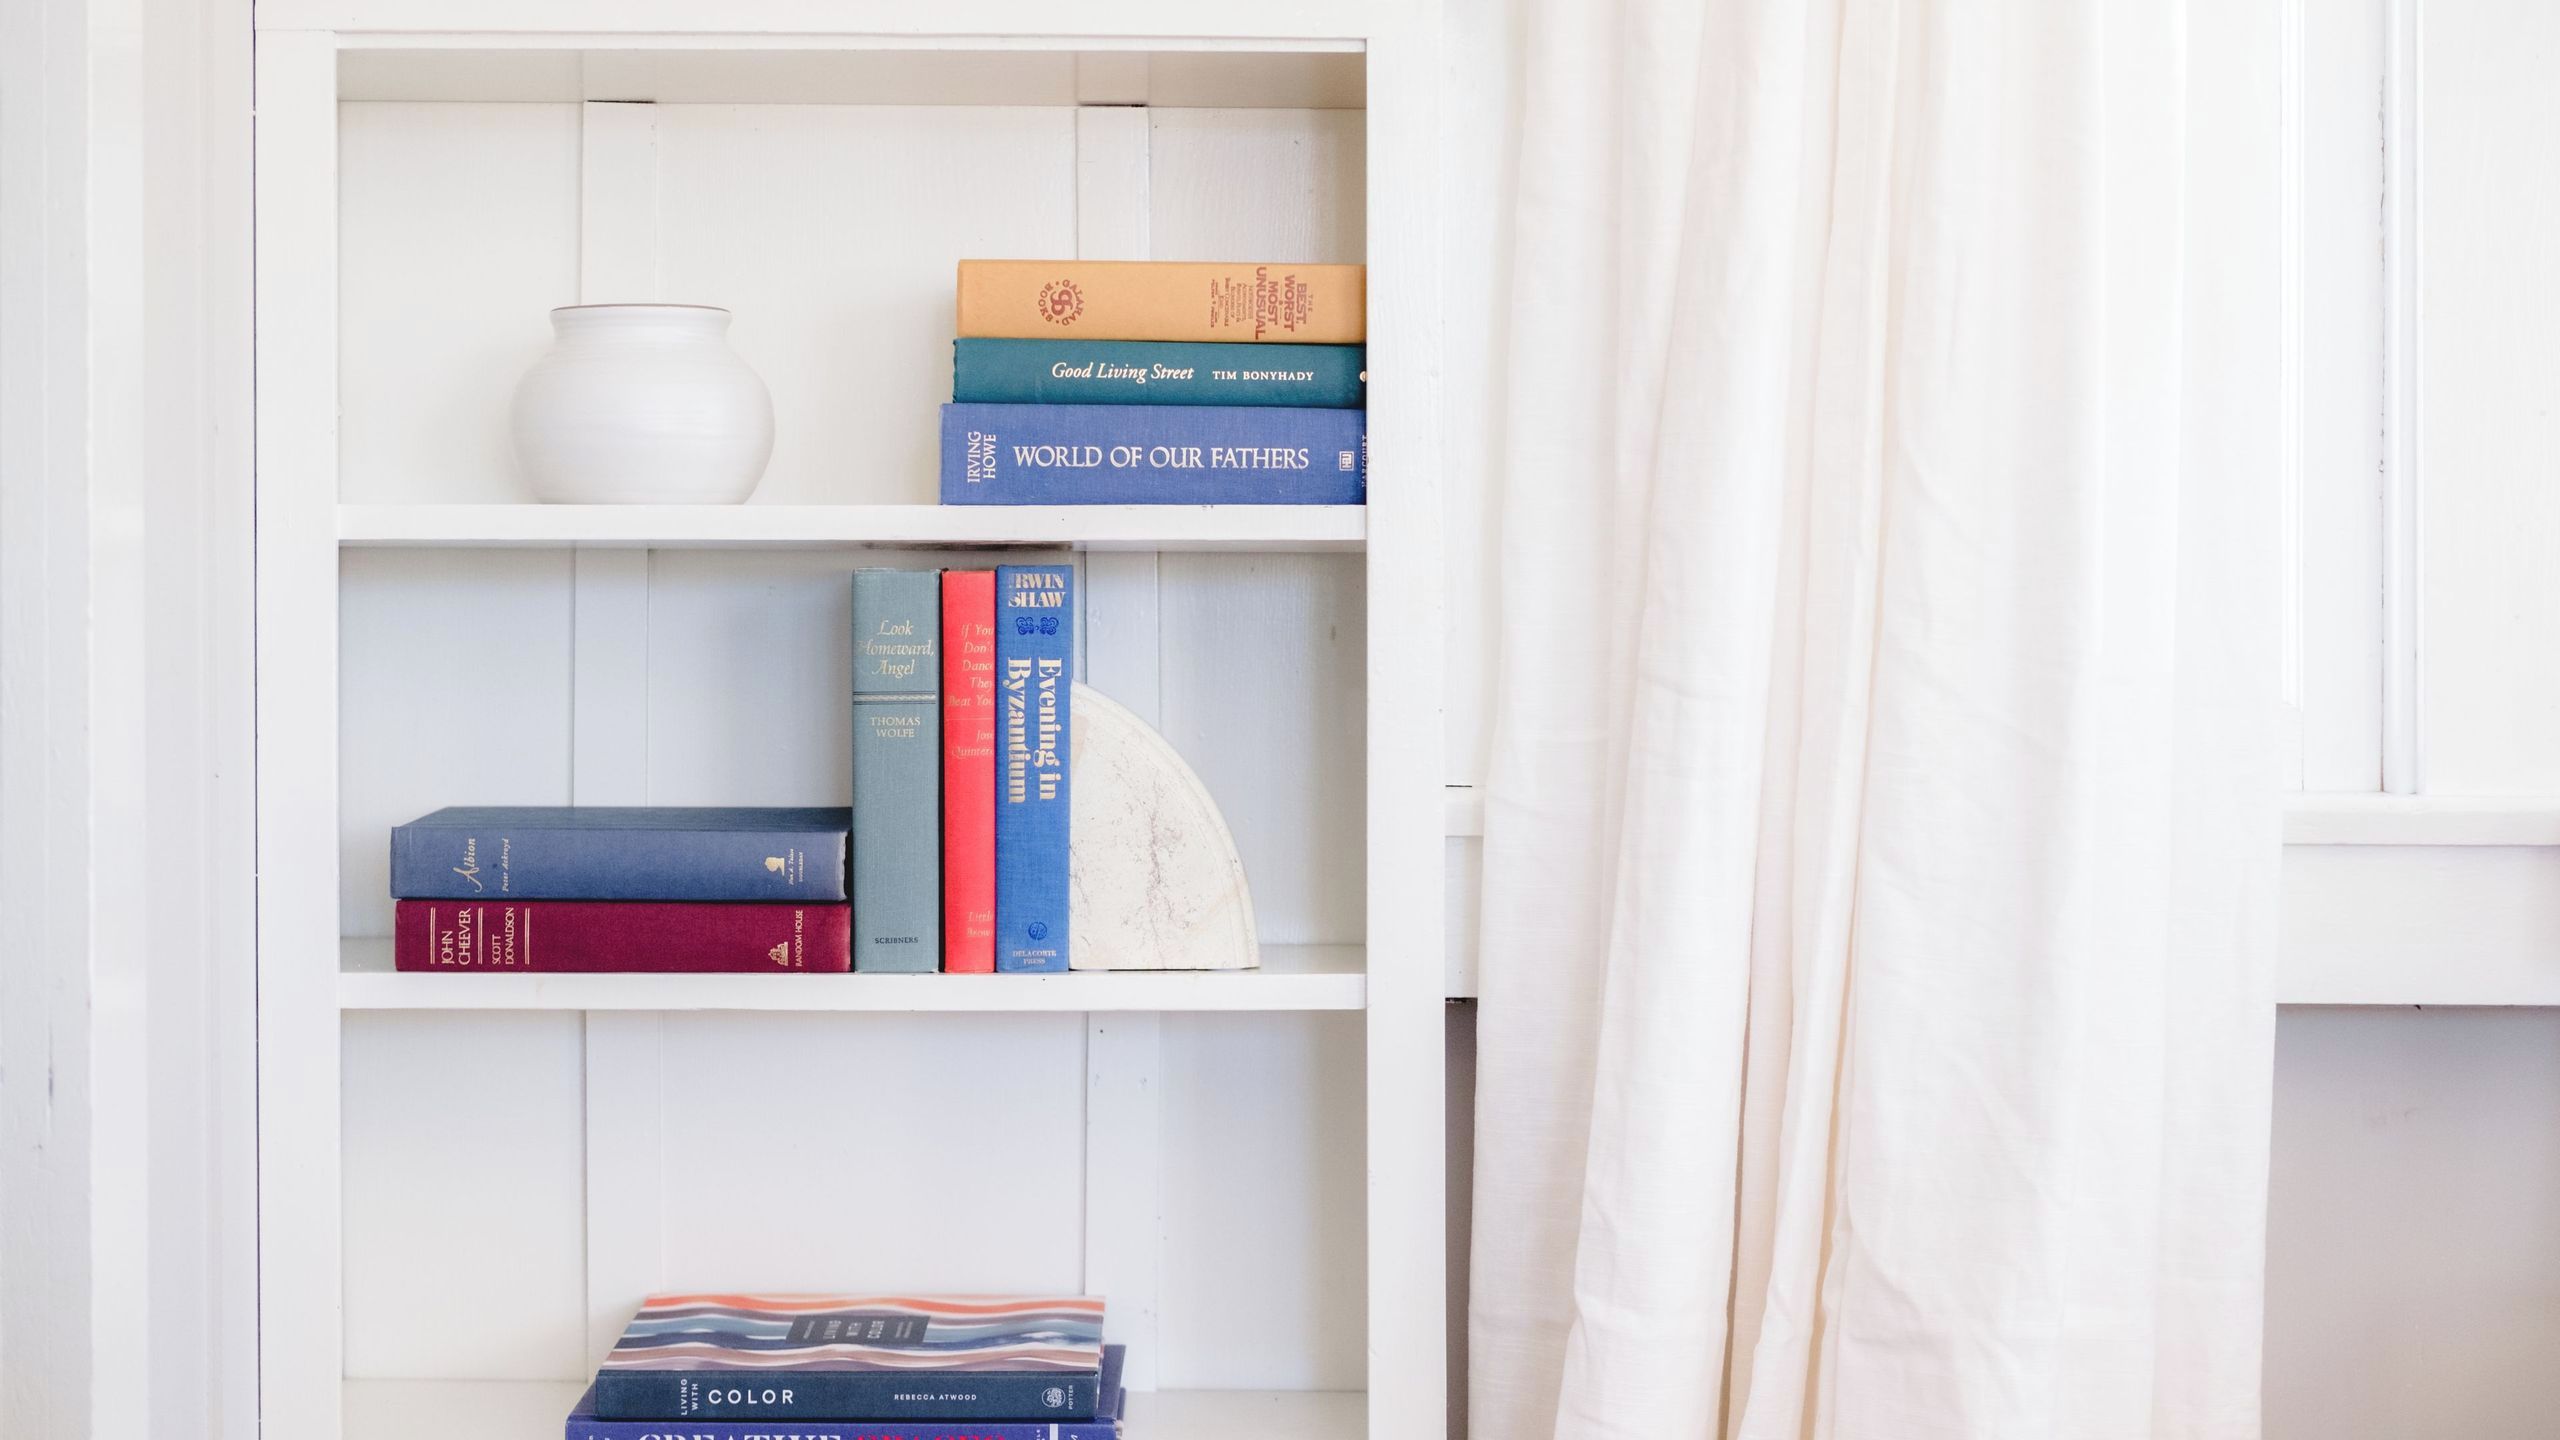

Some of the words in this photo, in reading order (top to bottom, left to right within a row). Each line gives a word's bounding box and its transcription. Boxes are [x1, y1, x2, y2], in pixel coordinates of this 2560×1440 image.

[1038, 282, 1054, 322] BOOKS
[1255, 266, 1267, 340] UNUSUAL
[1268, 281, 1278, 326] MOST
[1284, 275, 1295, 332] WORST
[1051, 361, 1094, 379] Good
[1096, 362, 1147, 384] Living
[1151, 363, 1195, 380] Street
[1212, 370, 1237, 380] TIM
[1243, 371, 1315, 381] BONYHADY
[967, 431, 981, 483] IRVING
[983, 434, 996, 479] HOWE
[1012, 445, 1103, 468] WORLD
[1110, 446, 1142, 468] OF
[1149, 446, 1205, 469] OUR
[1210, 447, 1309, 470] FATHERS
[1008, 573, 1064, 589] IRWIN
[1008, 592, 1066, 608] SHAW
[877, 619, 914, 636] Look
[961, 623, 971, 639] If
[872, 659, 915, 679] Angel
[870, 716, 921, 726] THOMAS
[1033, 656, 1062, 768] Evening
[876, 728, 915, 738] WOLFE
[1003, 656, 1031, 803] Byzantium
[1039, 772, 1062, 800] in
[453, 837, 483, 893] Albion
[501, 838, 511, 870] Ackroyd
[459, 908, 471, 965] CHEEVER
[505, 907, 514, 965] DONALDSON
[795, 909, 803, 933] HOUSE
[441, 930, 455, 964] JOHN
[492, 934, 501, 965] SCOTT
[795, 934, 803, 966] RANDOM
[874, 936, 919, 944] SCRIBNERS
[680, 1378, 688, 1416] LIVING
[691, 1383, 699, 1411] WITH
[708, 1389, 794, 1405] COLOR
